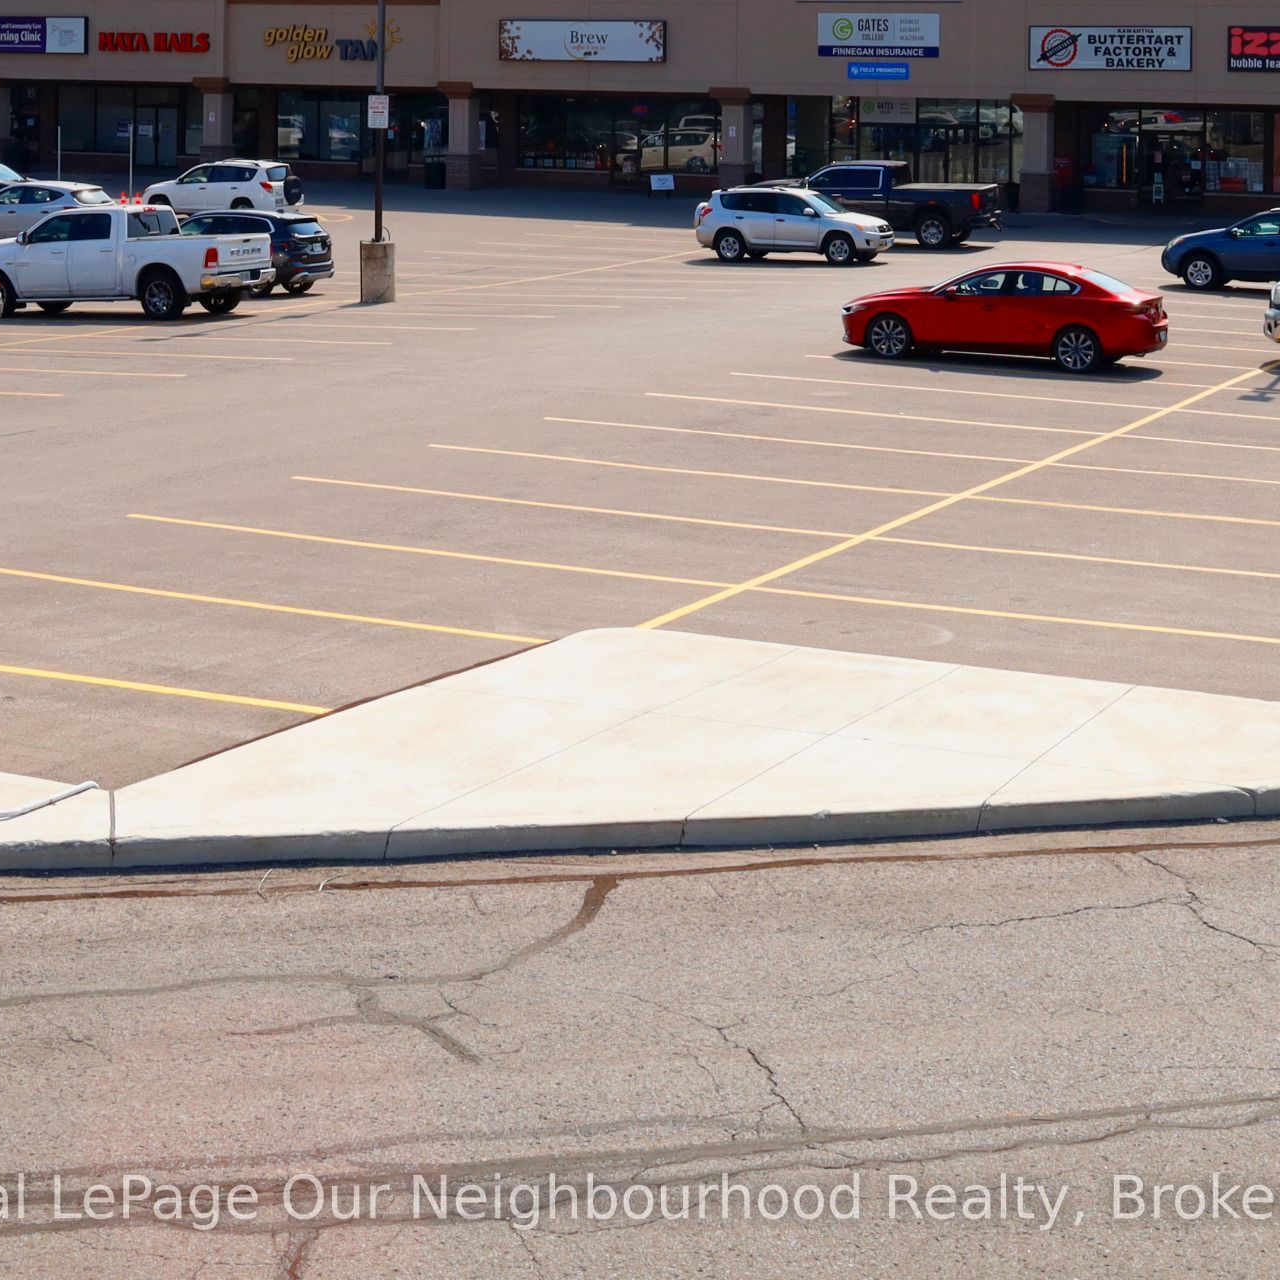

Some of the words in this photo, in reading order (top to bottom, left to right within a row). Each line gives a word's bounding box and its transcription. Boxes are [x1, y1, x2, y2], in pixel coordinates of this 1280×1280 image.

[857, 18, 889, 32] GATES
[20, 30, 41, 42] Clinic
[264, 24, 328, 47] golden
[569, 30, 609, 44] Brew
[861, 33, 885, 41] COLLEGE
[1087, 35, 1183, 46] BUTTERTART
[153, 32, 211, 53] NAILS
[287, 41, 333, 64] glow
[832, 48, 875, 56] FINNEGAN
[876, 48, 924, 56] INSURANCE
[1093, 46, 1164, 57] FACTORY
[1166, 46, 1177, 57] &
[1105, 57, 1165, 68] BAKERY
[1230, 57, 1262, 69] bubble
[877, 101, 894, 110] GATES
